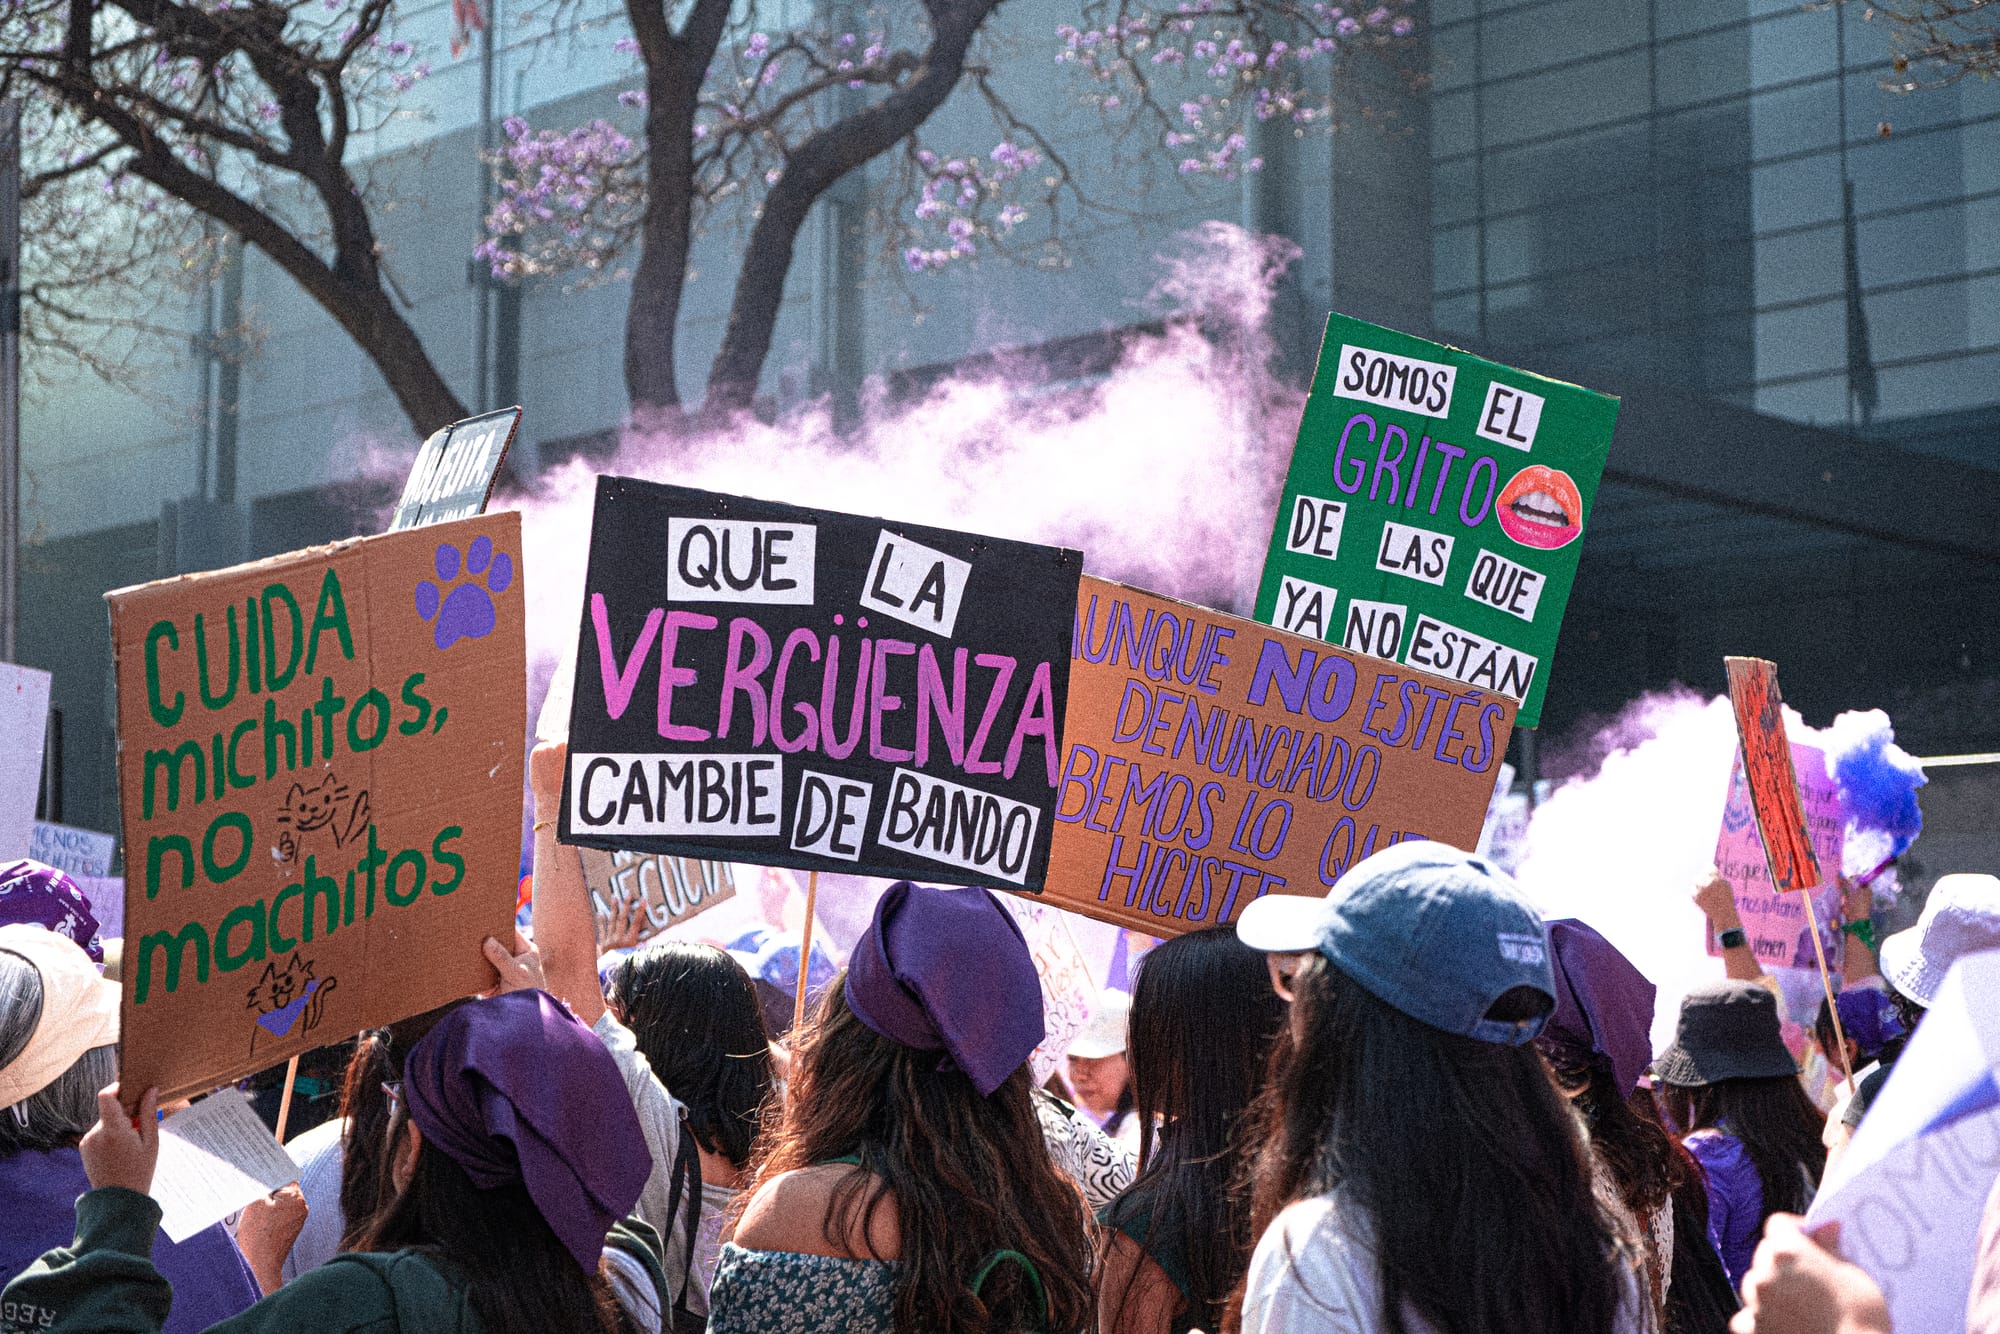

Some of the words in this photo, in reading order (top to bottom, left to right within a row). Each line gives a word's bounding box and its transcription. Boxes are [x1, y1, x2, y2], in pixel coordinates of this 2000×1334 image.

[1343, 351, 1448, 413] SOMOS
[1485, 387, 1528, 443] EL
[1333, 413, 1498, 528] GRITO
[677, 524, 797, 591] QUE
[869, 541, 947, 623] LA
[1290, 497, 1342, 558] DE
[1379, 525, 1447, 579] LAS
[1471, 554, 1538, 616] QUE
[144, 568, 355, 728] CUIDA
[591, 593, 1060, 787] VERGÜENZA
[1284, 580, 1324, 640] YA
[1344, 605, 1402, 659] NO
[1410, 622, 1535, 699] ESTÁN
[142, 672, 449, 821] michitos,
[1113, 678, 1383, 812] DENUNCIADO
[1248, 637, 1358, 723] NO
[1360, 674, 1505, 774] ESTÉS
[146, 811, 254, 900] no
[578, 757, 777, 826] CAMBIE
[794, 776, 868, 856] DE
[884, 773, 1032, 875] BANDO
[1229, 789, 1294, 862] LO
[135, 824, 466, 1005] machitos
